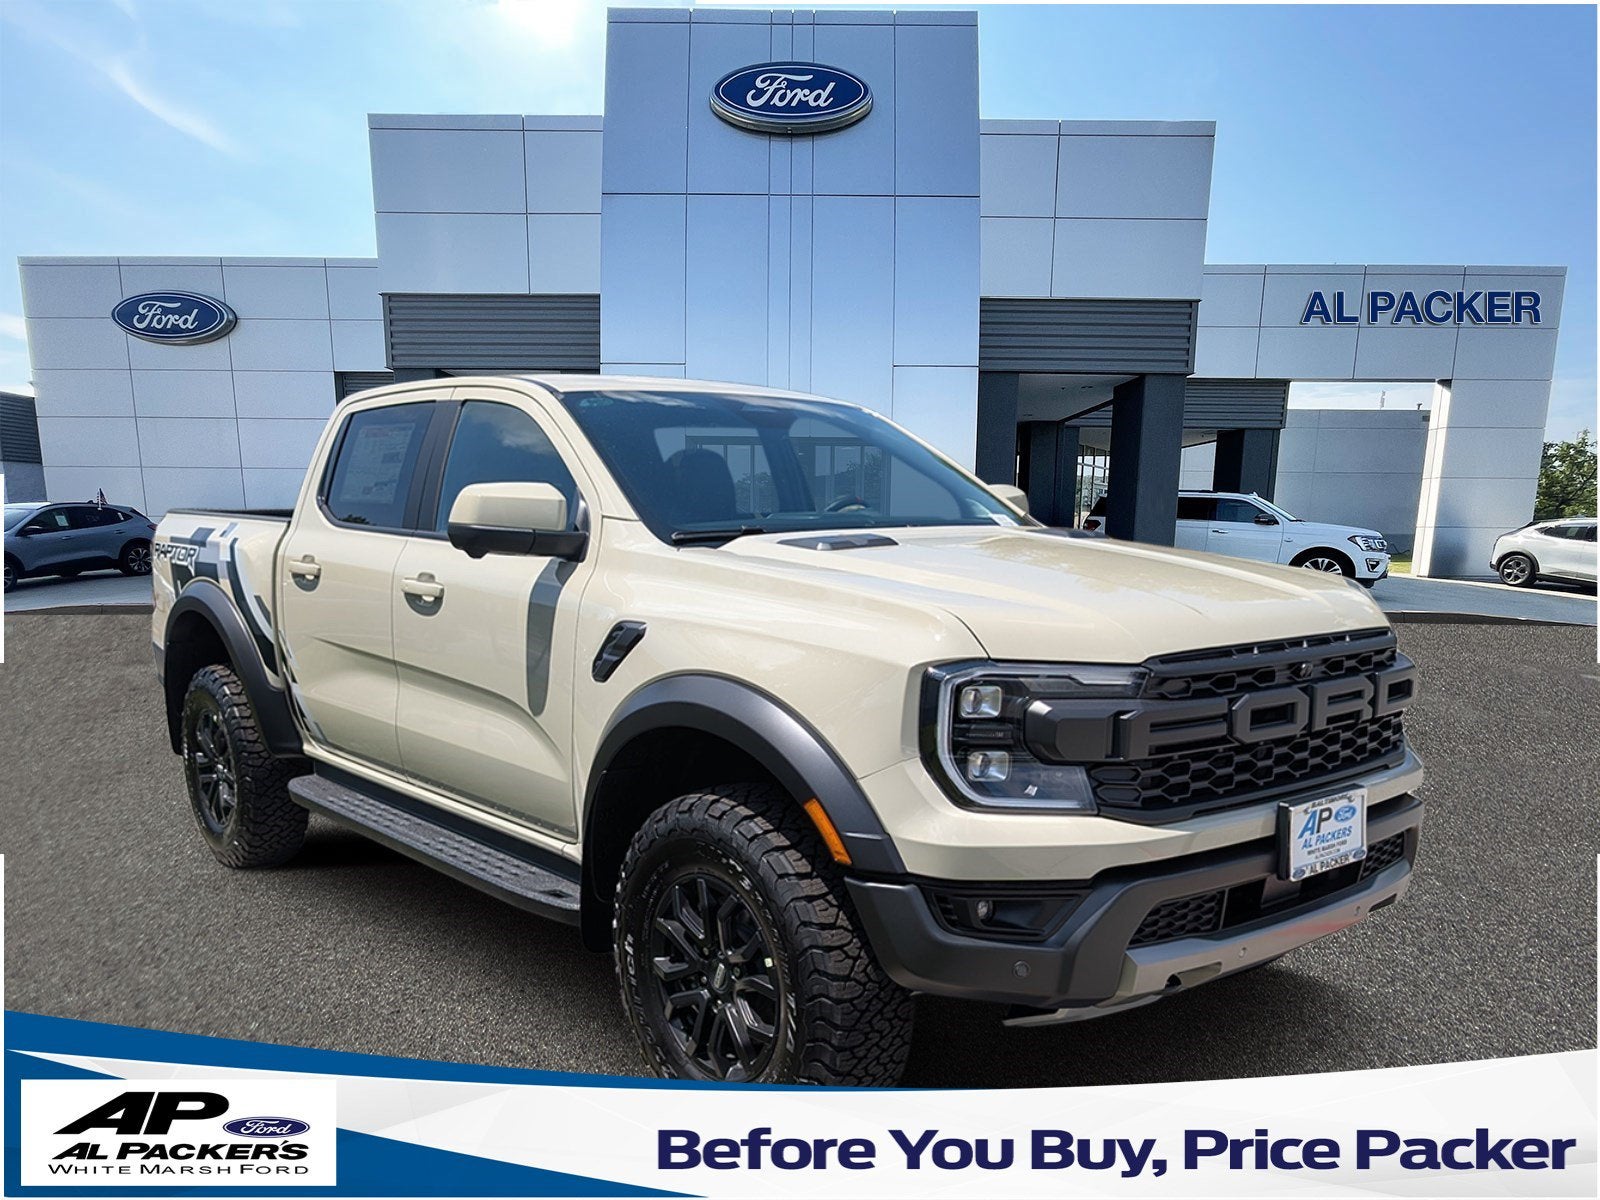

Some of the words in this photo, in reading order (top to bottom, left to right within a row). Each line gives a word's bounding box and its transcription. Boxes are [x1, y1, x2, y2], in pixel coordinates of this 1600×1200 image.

[746, 73, 837, 107] Ford
[133, 301, 199, 329] Ford
[1302, 290, 1360, 324] AL
[1368, 290, 1542, 324] PACKER
[154, 542, 198, 569] RAPTOR
[1121, 665, 1416, 759] FORD
